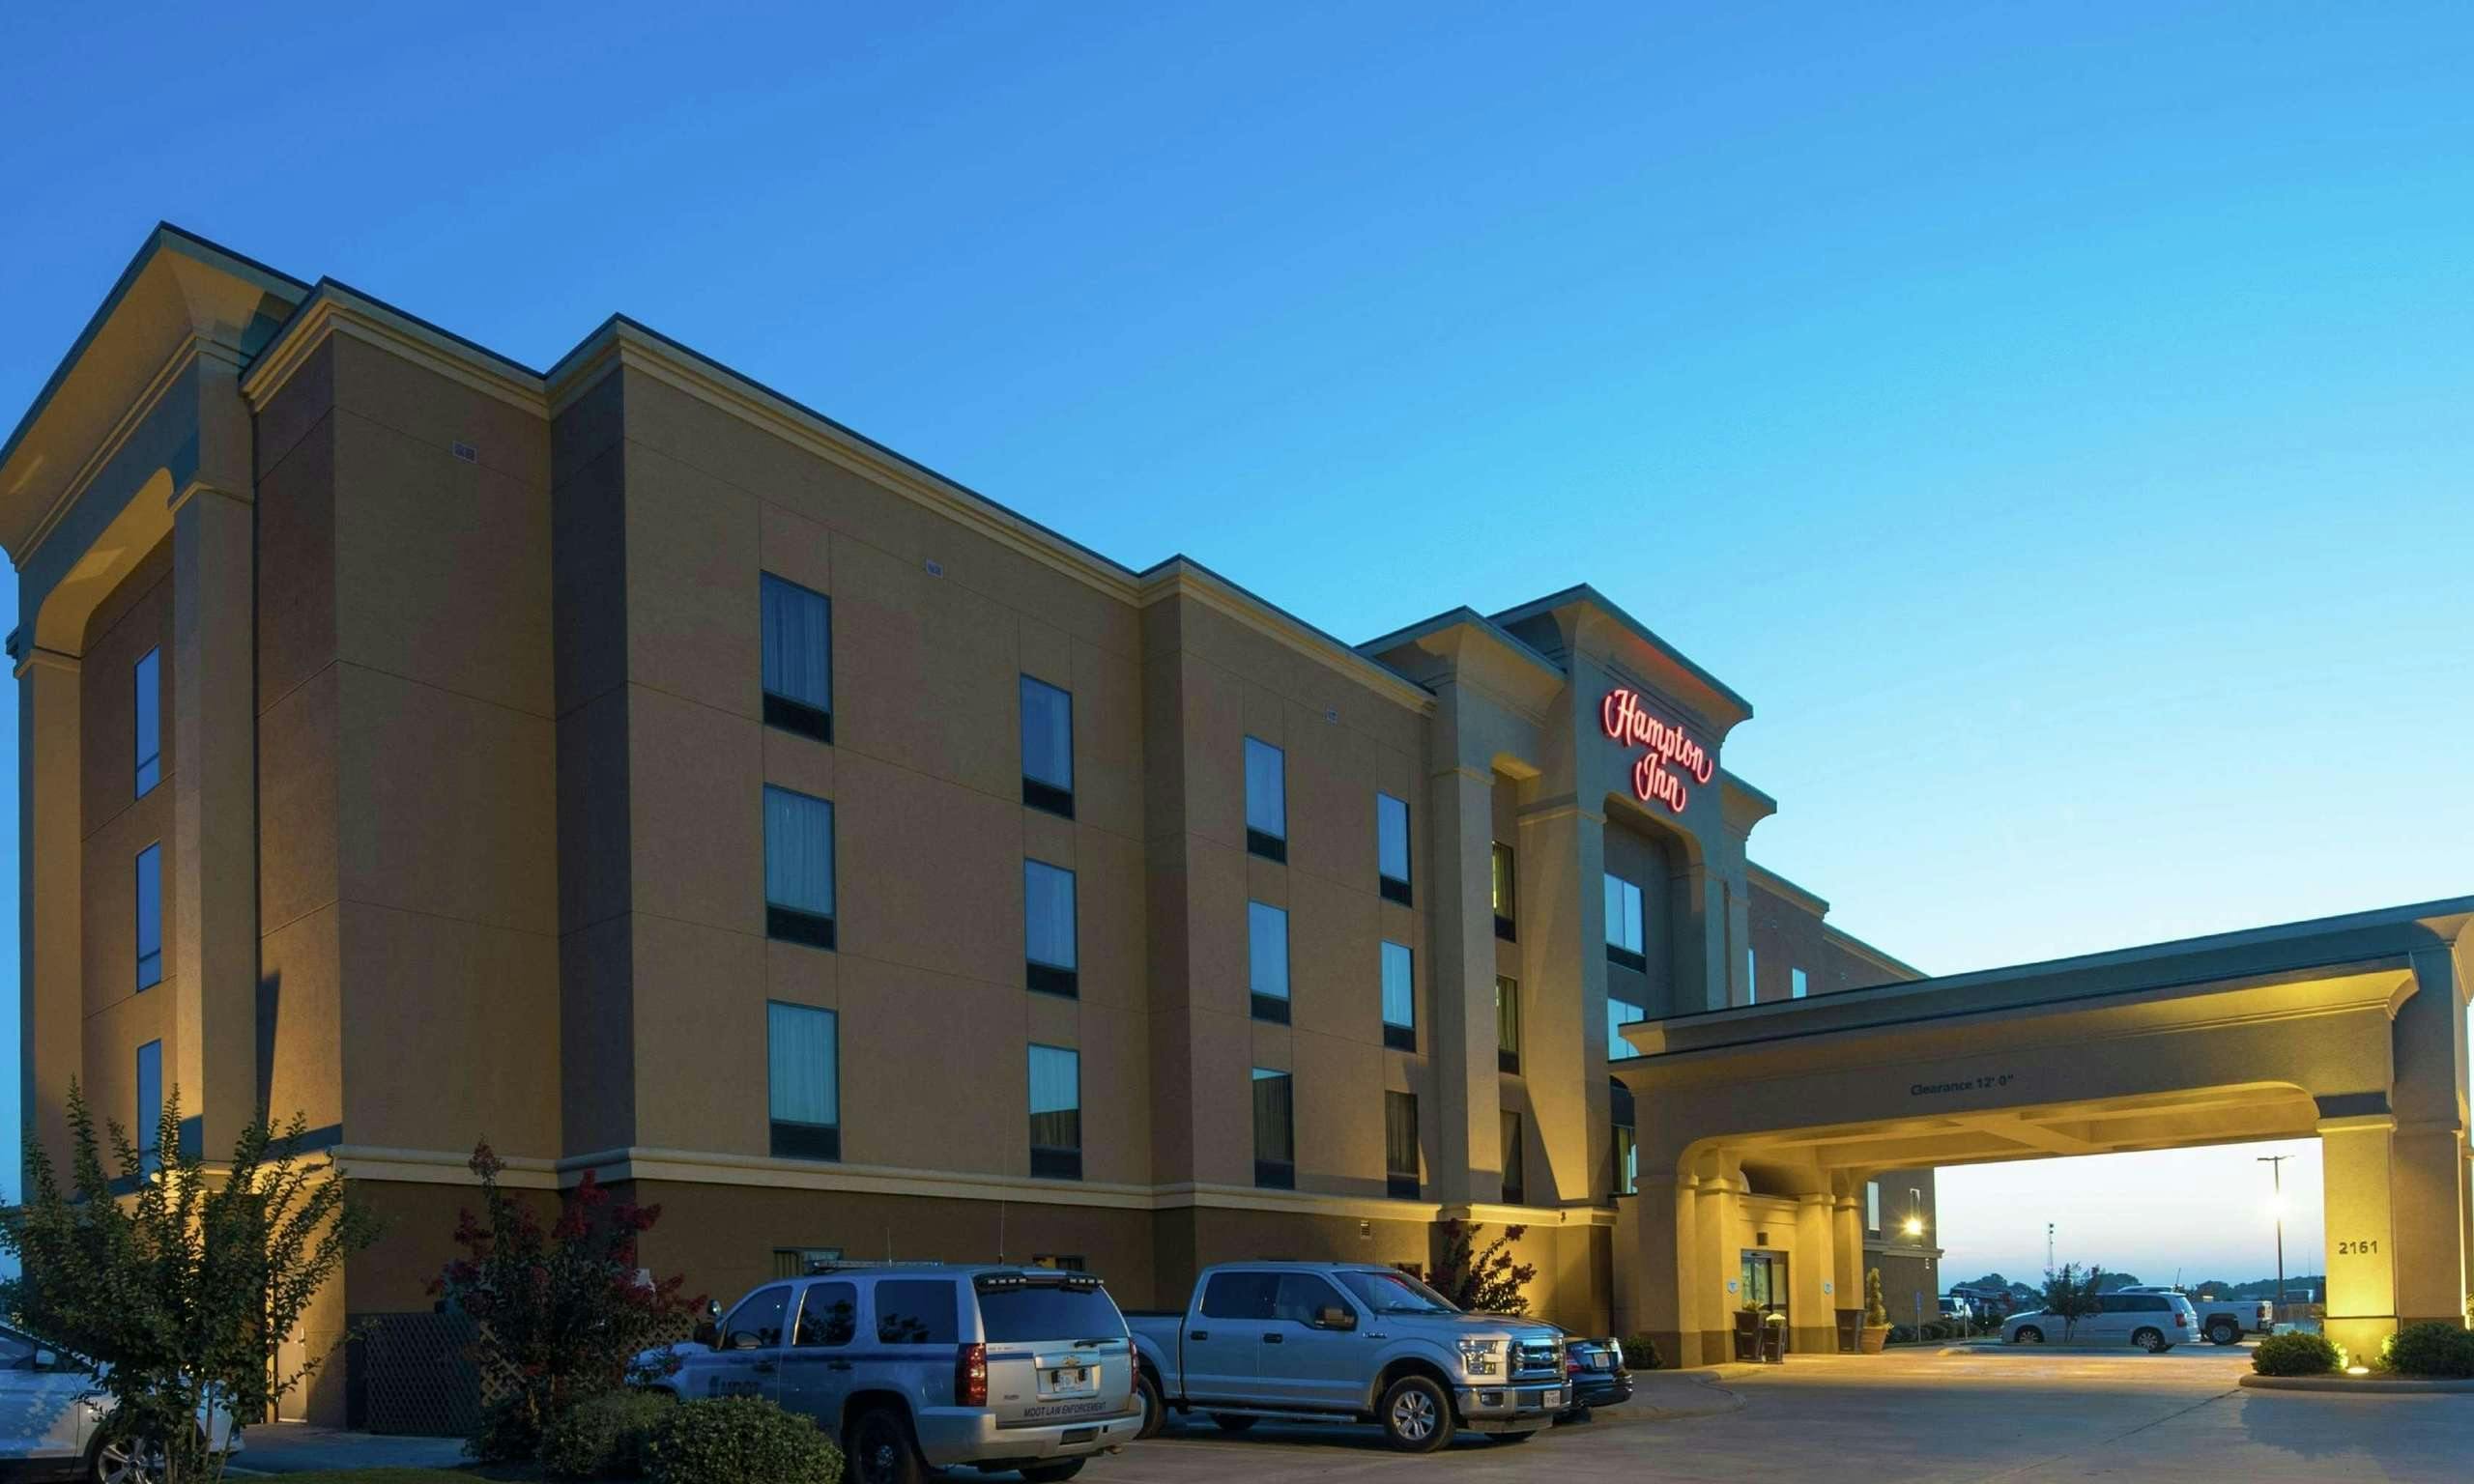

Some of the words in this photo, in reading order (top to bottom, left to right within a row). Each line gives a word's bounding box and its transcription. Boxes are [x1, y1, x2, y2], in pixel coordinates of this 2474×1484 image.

[1603, 689, 1713, 784] Hampton
[1635, 753, 1686, 813] Inn
[1911, 1082, 1972, 1096] Clearance
[2339, 1241, 2377, 1255] 2161
[1046, 1405, 1061, 1415] LAW
[1062, 1401, 1107, 1415] ENFORCEMENT
